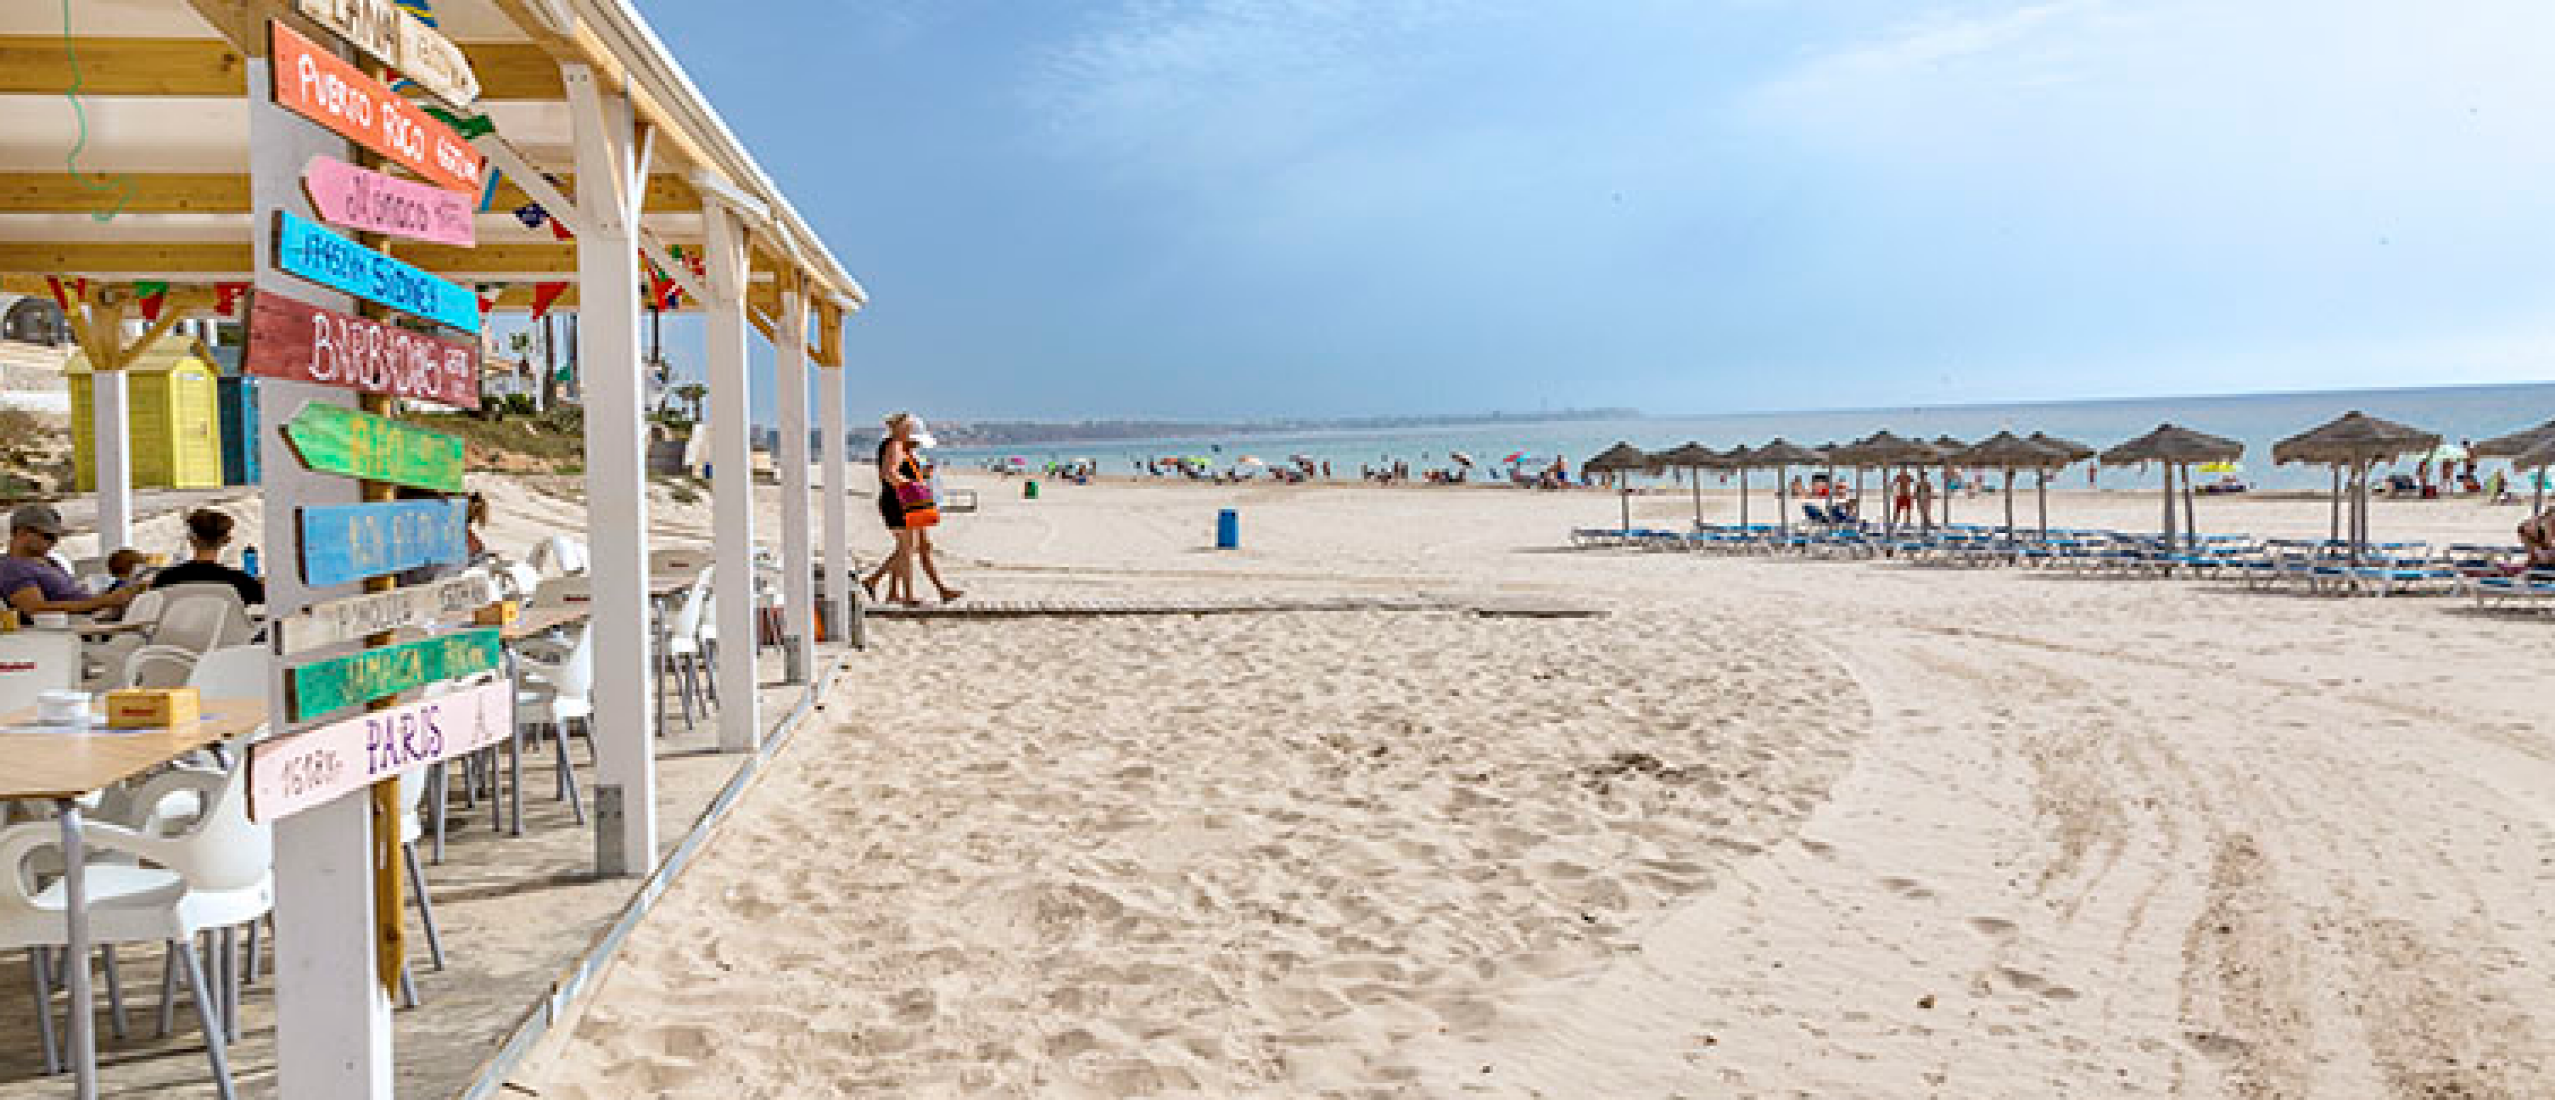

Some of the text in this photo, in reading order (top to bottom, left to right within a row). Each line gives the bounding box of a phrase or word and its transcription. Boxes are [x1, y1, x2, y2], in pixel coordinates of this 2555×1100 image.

[297, 53, 372, 128] PUERTO
[382, 99, 426, 163] RICO
[308, 311, 442, 396] BARBADOS
[366, 704, 446, 774] PARIS
